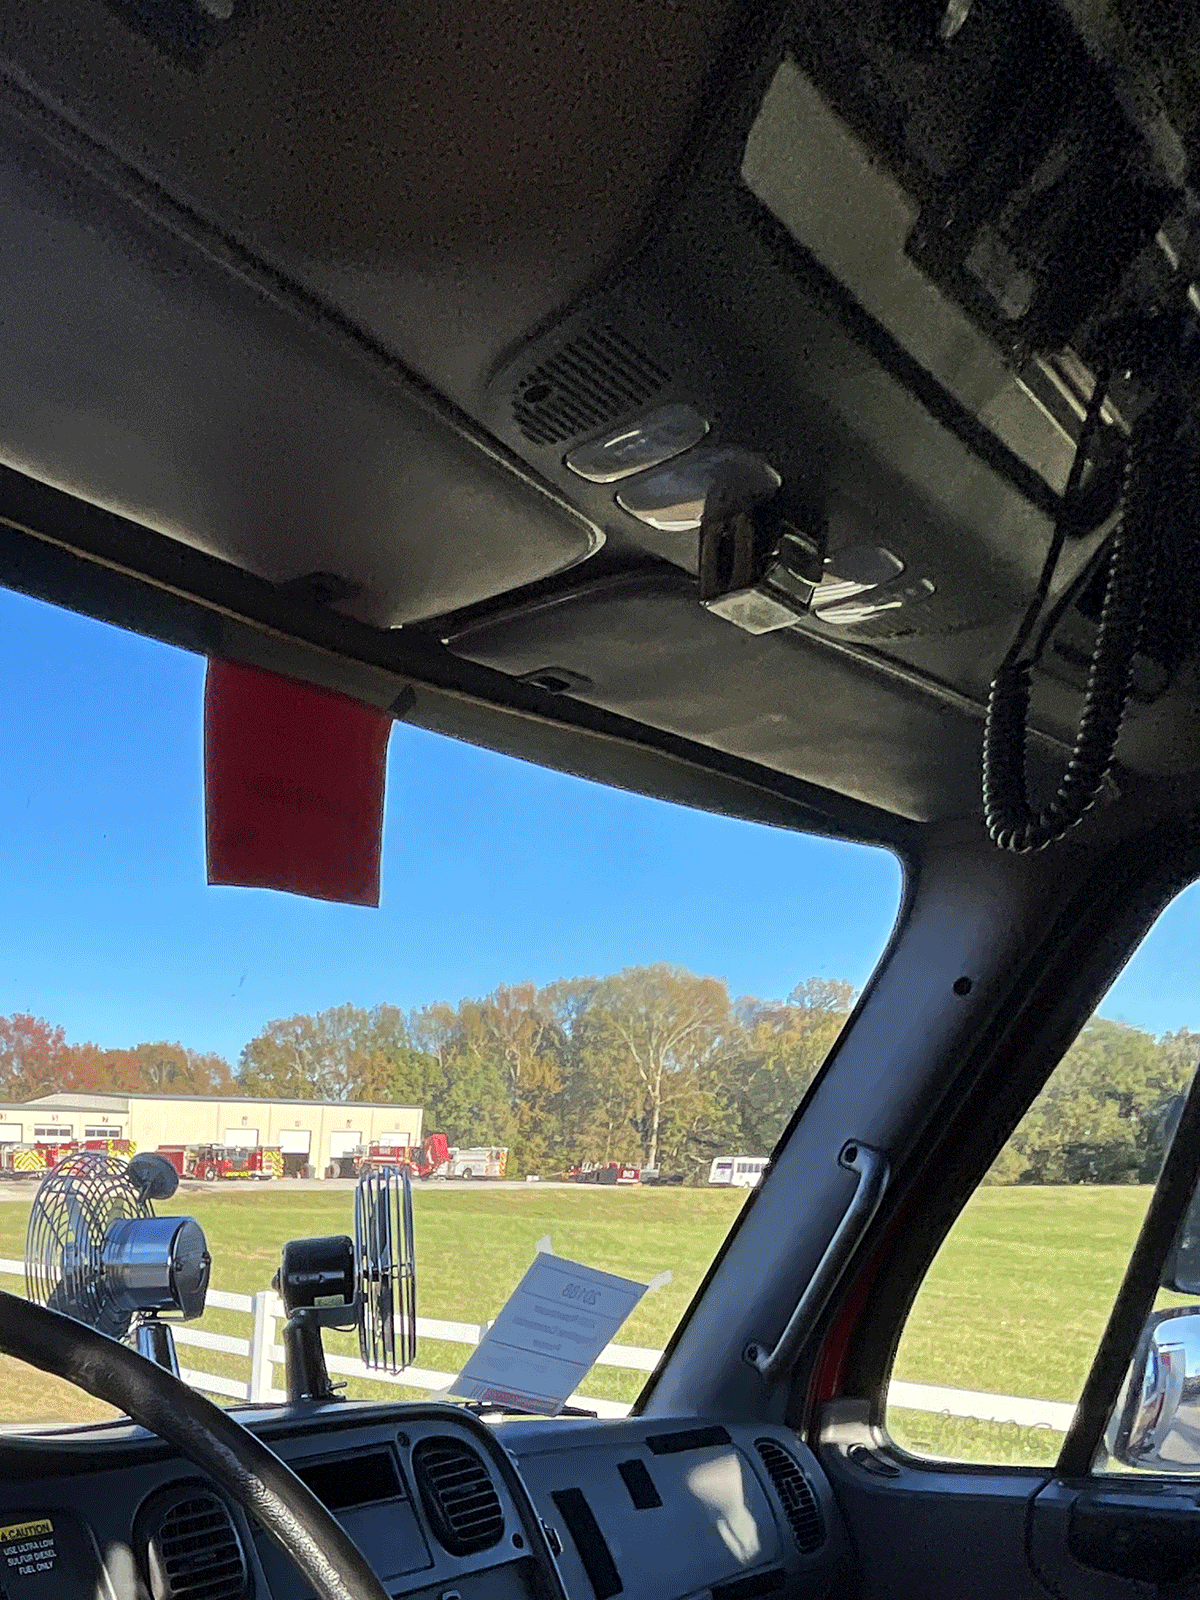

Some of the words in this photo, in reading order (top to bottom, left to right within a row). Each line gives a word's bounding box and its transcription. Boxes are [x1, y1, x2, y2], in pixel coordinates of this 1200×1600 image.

[8, 1522, 50, 1540] CAUTION
[3, 1545, 18, 1556] USE
[17, 1541, 39, 1553] ULTRA
[39, 1539, 54, 1548] LOW
[7, 1554, 33, 1567] SULFUR
[34, 1549, 57, 1561] DIESEL
[19, 1565, 36, 1575] FUEL
[36, 1561, 53, 1571] ONLY
